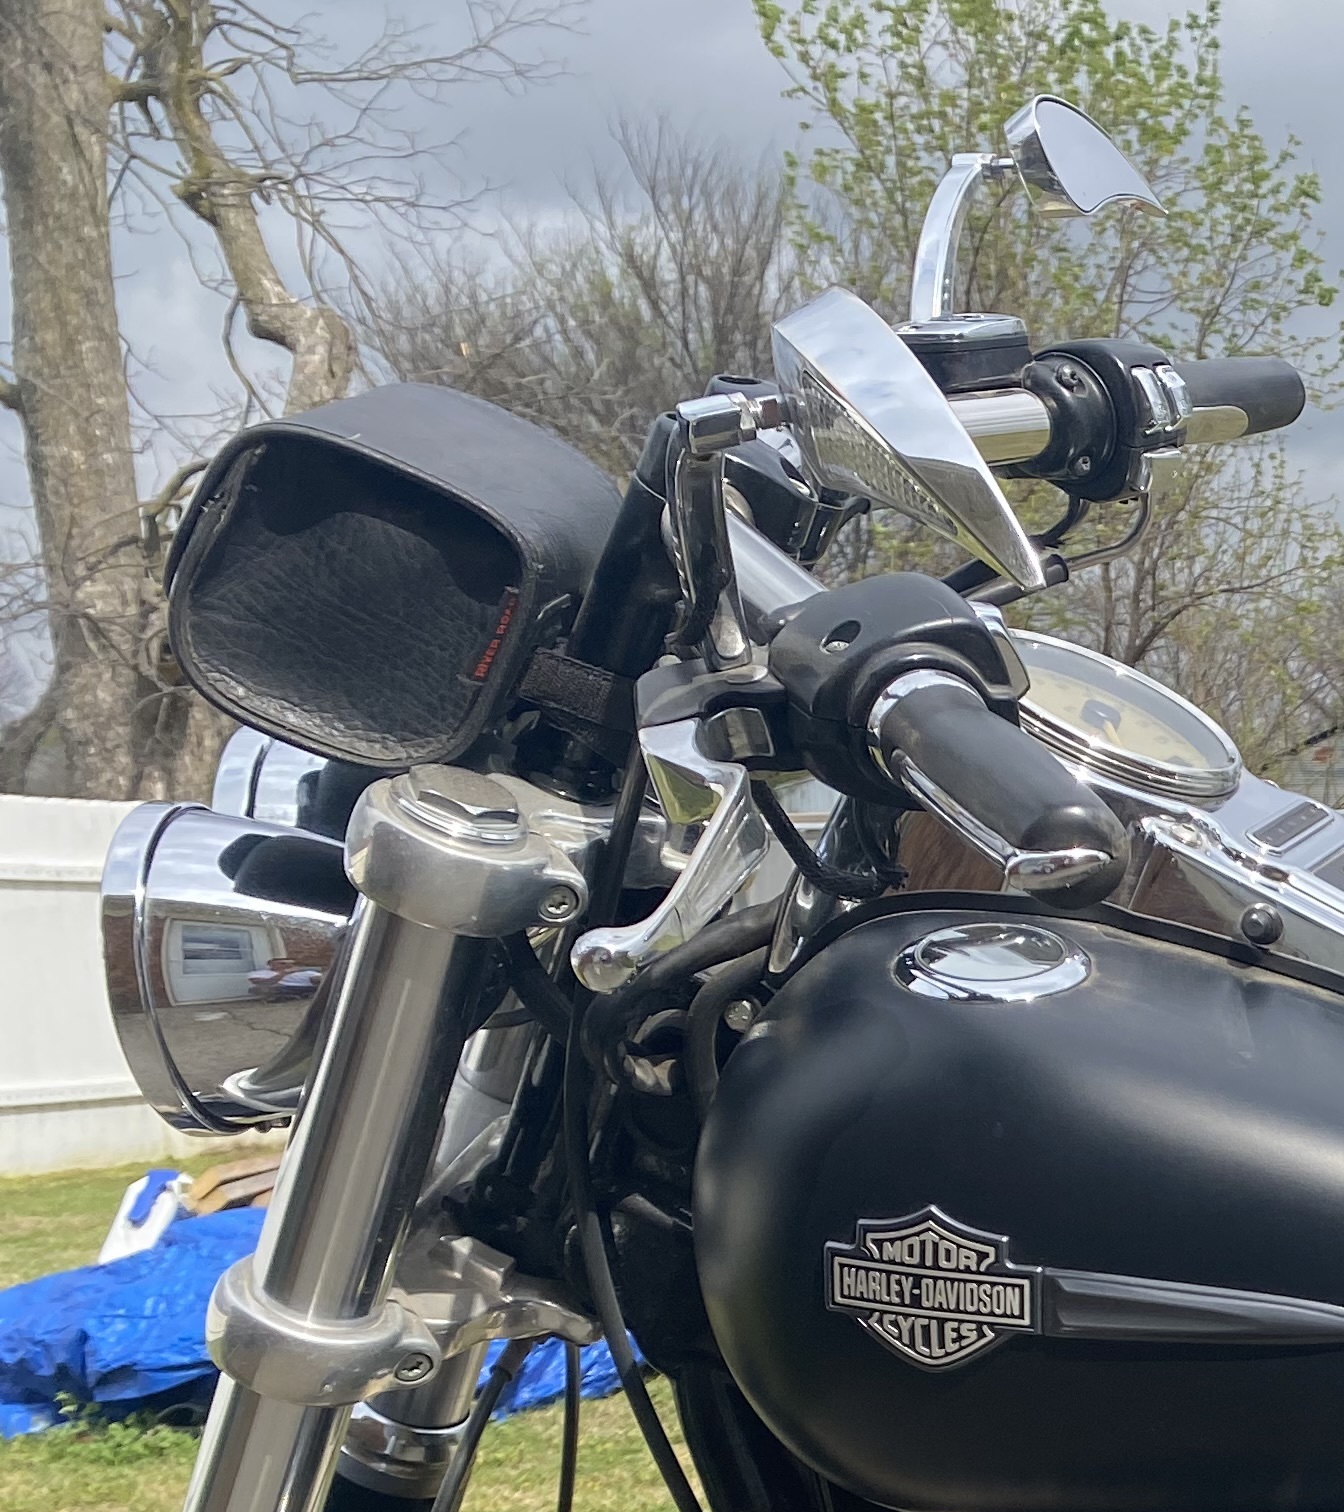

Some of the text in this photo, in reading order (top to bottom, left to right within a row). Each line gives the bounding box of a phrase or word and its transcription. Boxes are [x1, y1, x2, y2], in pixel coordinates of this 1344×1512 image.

[882, 1231, 978, 1272] MOTOR
[842, 1266, 1020, 1316] HARLEY-DAVIDSON
[882, 1313, 977, 1357] CYCLES
